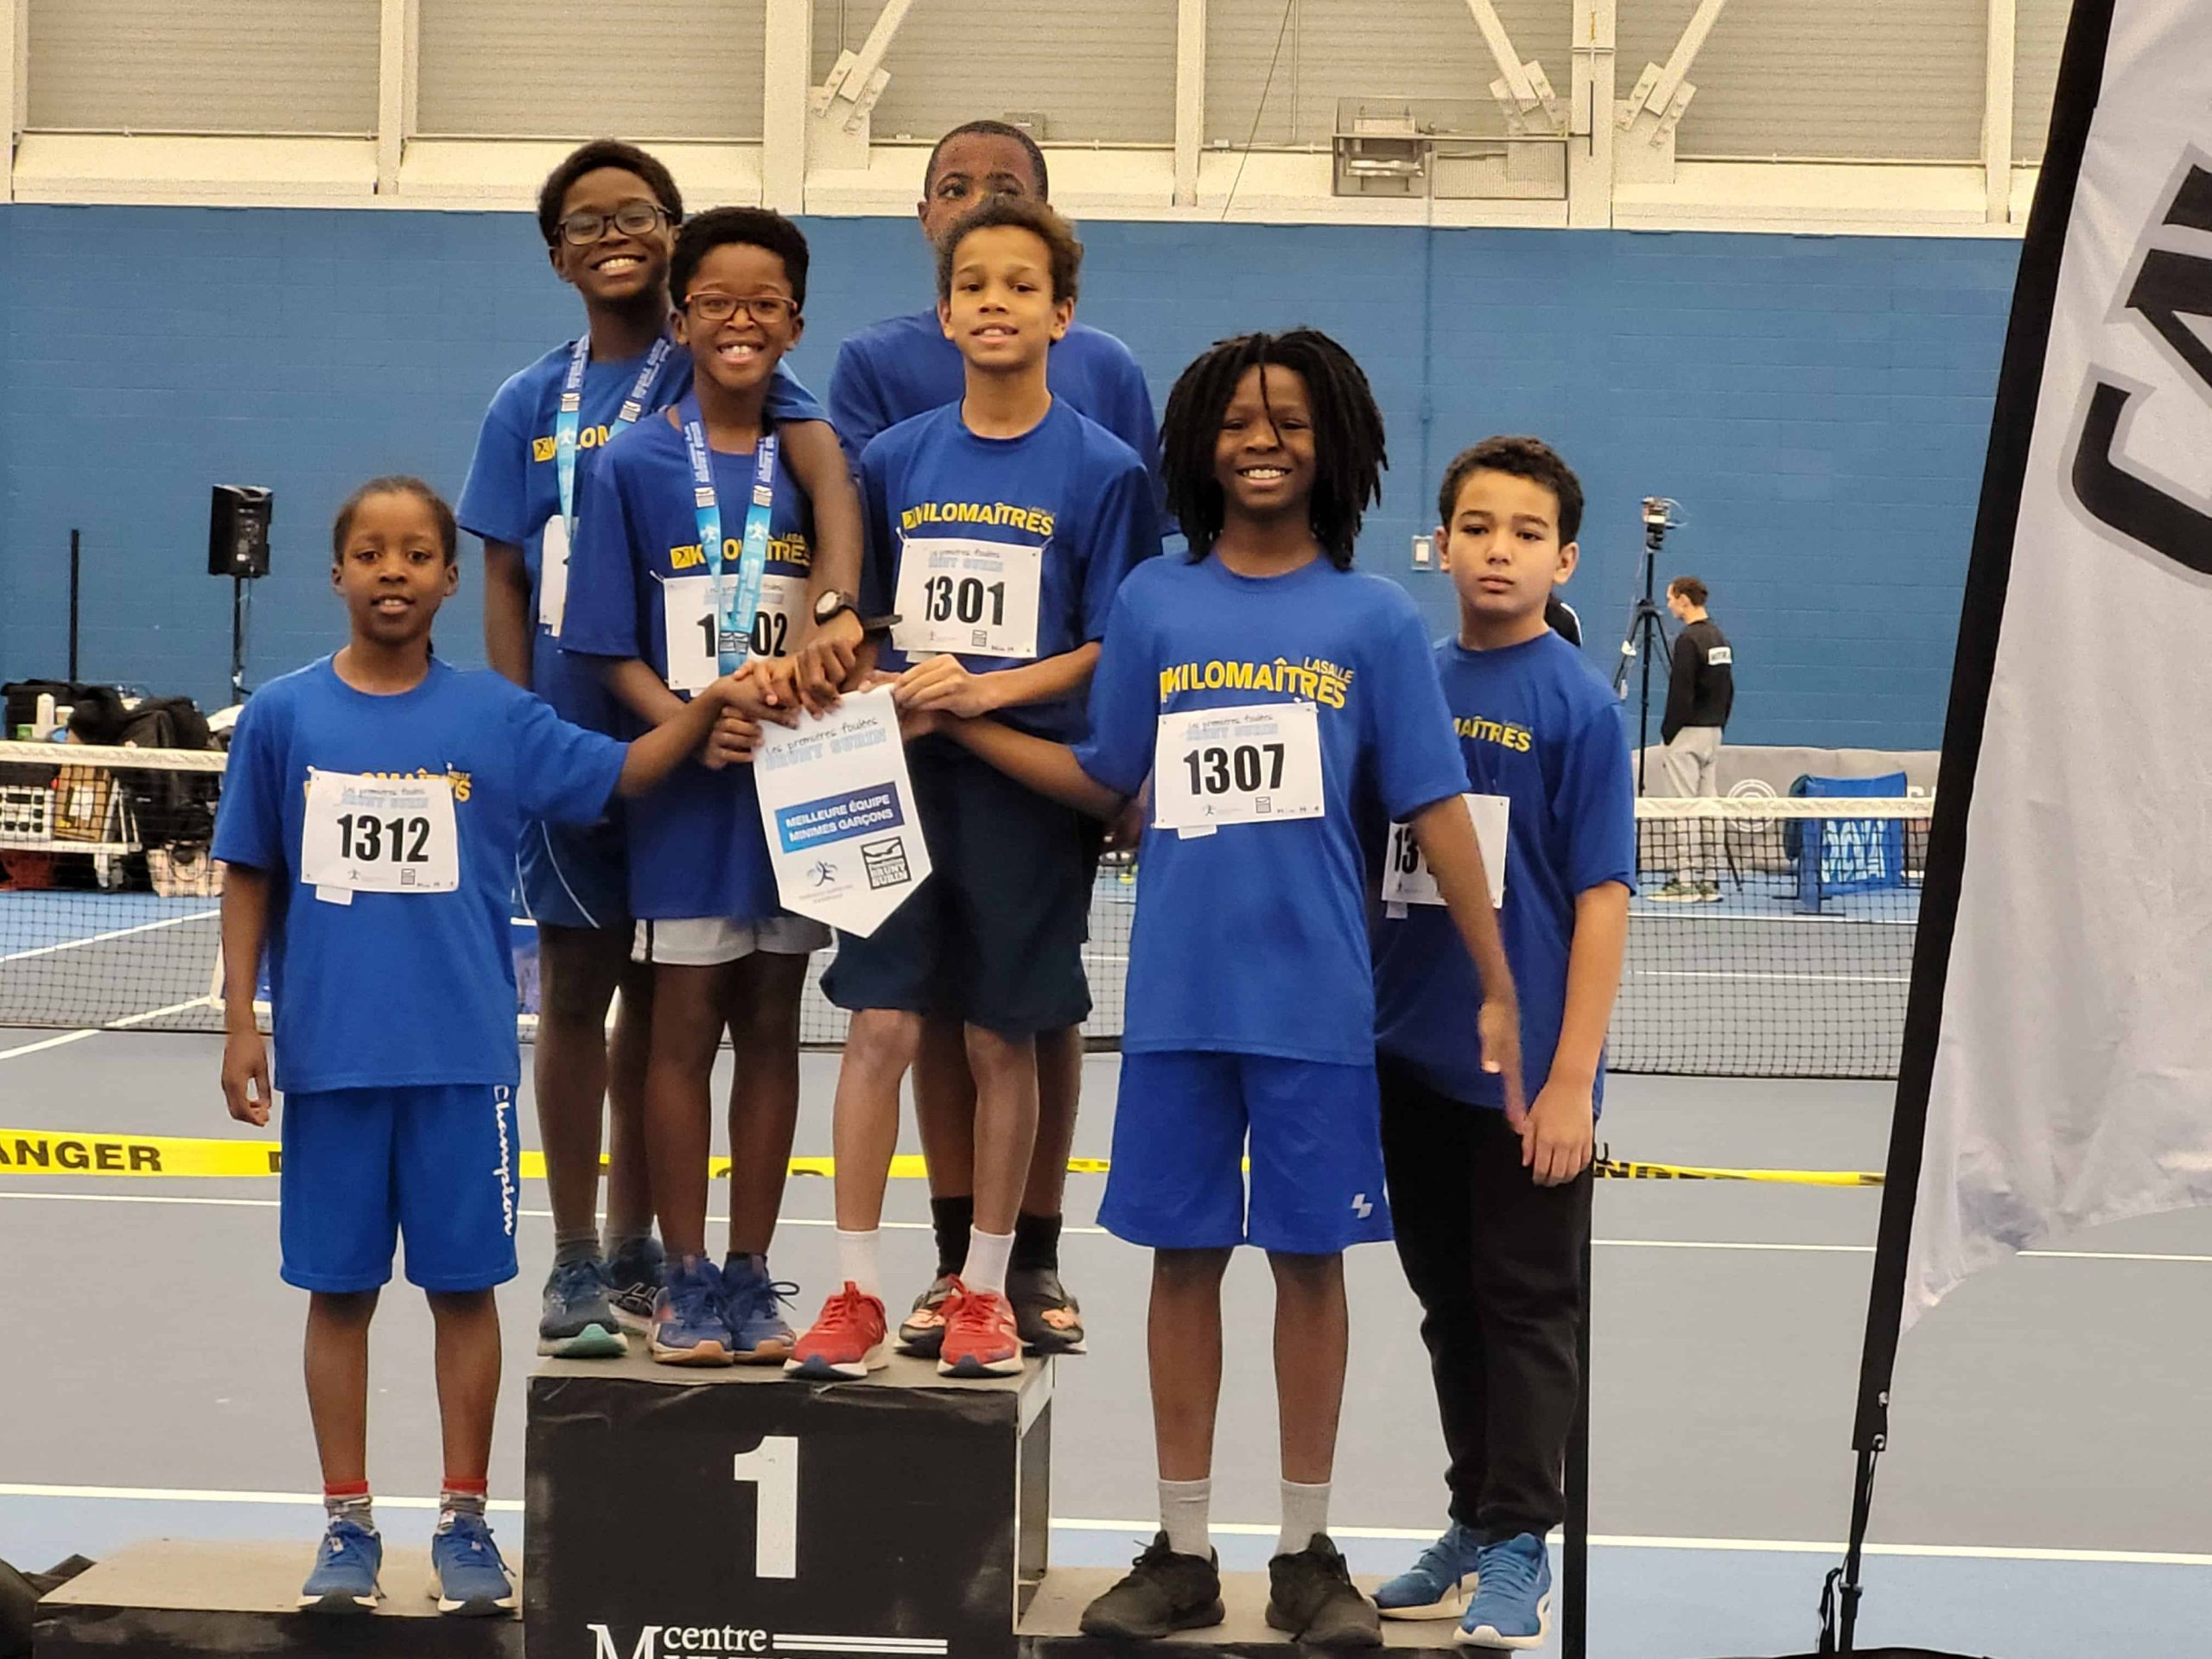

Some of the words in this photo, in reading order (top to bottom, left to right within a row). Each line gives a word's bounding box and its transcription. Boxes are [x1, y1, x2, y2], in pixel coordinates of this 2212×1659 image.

[925, 575, 1005, 626] 1301
[696, 610, 788, 658] 102
[1166, 657, 1347, 709] KILOMAÎTRES
[1304, 656, 1355, 684] LASALLE
[1452, 716, 1532, 753] AÎTRES
[1183, 743, 1285, 796] 1307
[785, 804, 849, 828] MEILLEURE
[849, 794, 891, 813] ÉQUIPE
[788, 822, 837, 842] MINIMES
[838, 809, 893, 830] GARÇONS
[336, 813, 430, 862] 1312
[1394, 827, 1420, 874] 13
[0, 1139, 162, 1172] NGER
[493, 1085, 516, 1236] Champion
[734, 1435, 799, 1579] 1
[663, 1624, 767, 1651] centre
